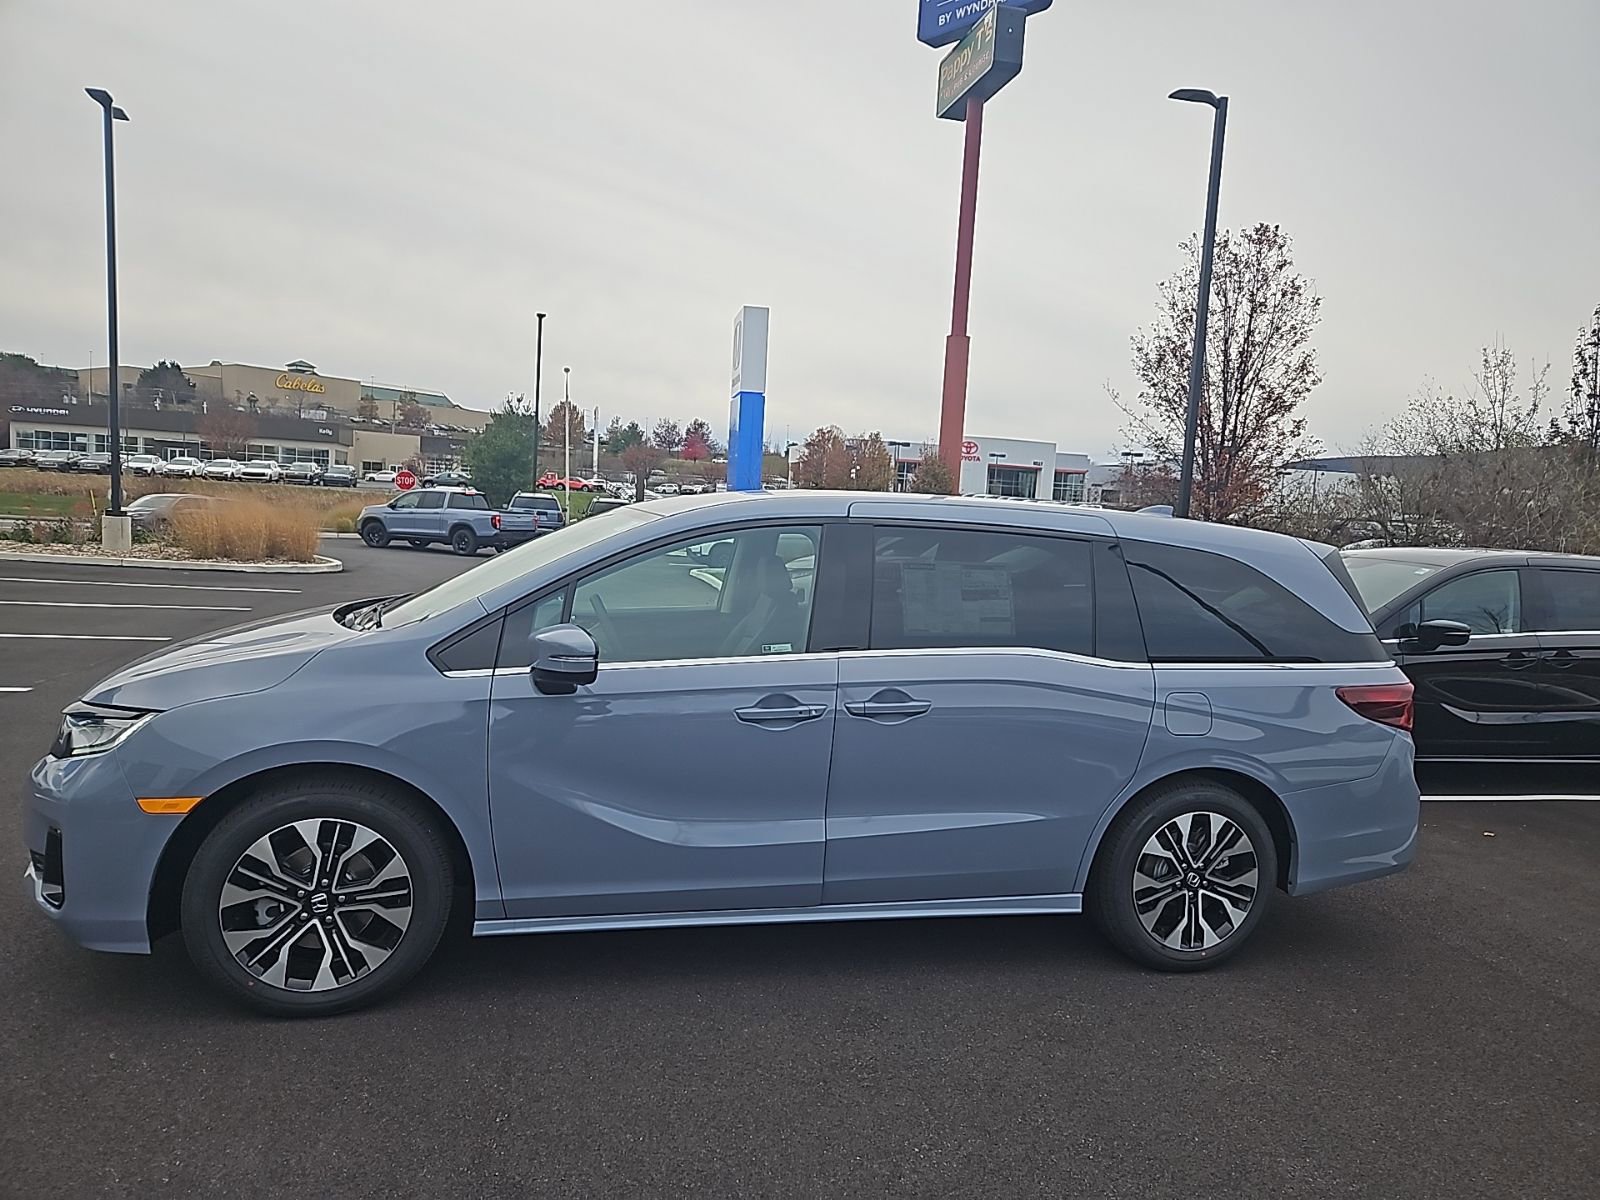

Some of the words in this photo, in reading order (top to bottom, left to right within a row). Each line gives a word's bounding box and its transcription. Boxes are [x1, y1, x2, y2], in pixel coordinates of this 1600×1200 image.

[938, 11, 952, 26] BY
[956, 0, 1006, 19] WYNDH
[941, 41, 975, 88] Pappy
[396, 476, 415, 486] STOP
